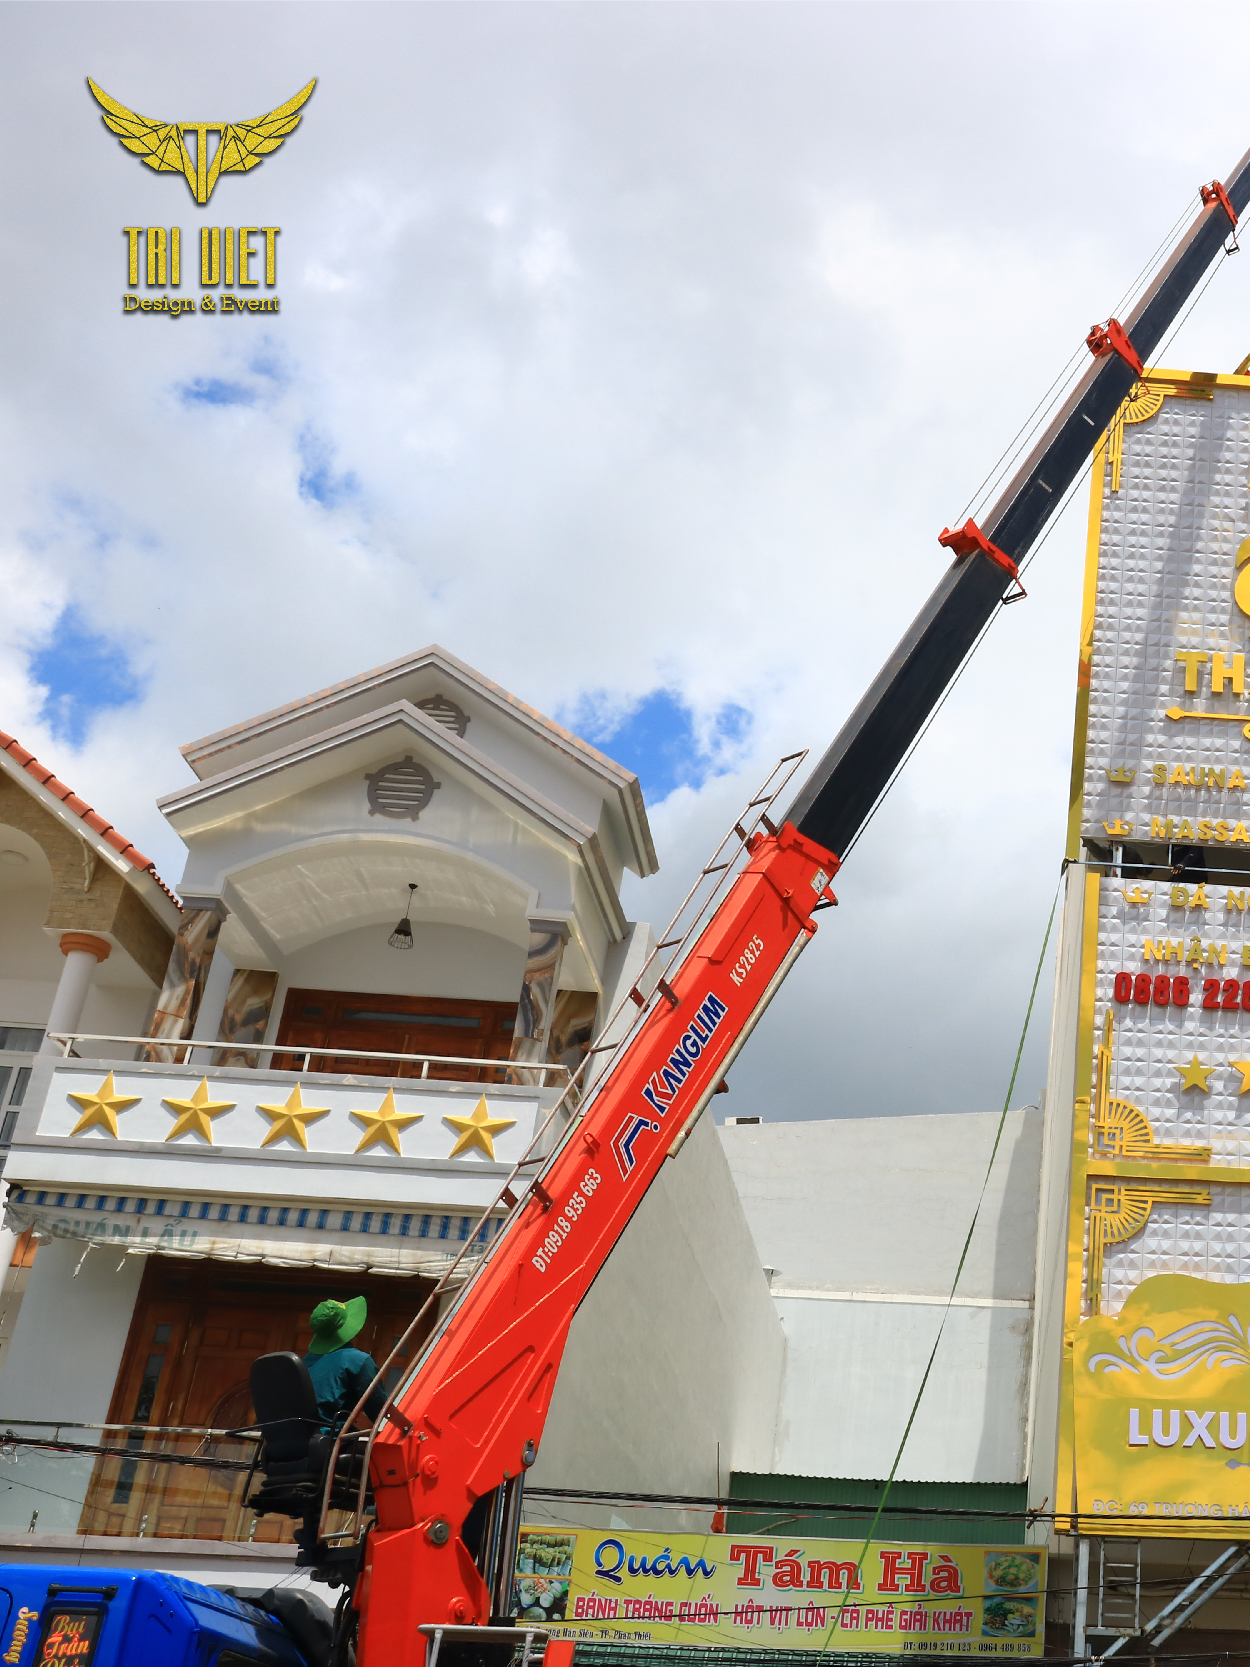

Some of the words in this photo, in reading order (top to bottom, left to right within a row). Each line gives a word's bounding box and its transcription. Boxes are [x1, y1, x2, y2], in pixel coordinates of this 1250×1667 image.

[1152, 764, 1248, 790] SAUNA
[1170, 882, 1209, 909] ĐÁ
[729, 934, 765, 987] KS2825
[1143, 936, 1228, 969] NHẬN
[1114, 971, 1190, 1006] 0886
[641, 991, 728, 1117] KANGLIM
[52, 1218, 130, 1239] QUÁN
[140, 1219, 199, 1248] LẨU
[532, 1216, 571, 1273] ĐT:0918
[564, 1191, 587, 1221] 935
[580, 1168, 601, 1197] 663
[1093, 1499, 1123, 1513] ĐC:
[1129, 1501, 1148, 1515] 69
[594, 1538, 717, 1585] Quán
[729, 1544, 863, 1592] Tám
[877, 1550, 964, 1596] Hà
[573, 1590, 619, 1620] BÁNH
[623, 1592, 674, 1623] TRÁNG
[677, 1592, 721, 1625] CUỐN
[732, 1598, 764, 1632] HỘT
[769, 1605, 793, 1633] VỊT
[796, 1600, 827, 1634] LỘN
[840, 1602, 861, 1631] CÀ
[864, 1603, 895, 1631] PHÊ
[898, 1602, 929, 1632] GIẢI
[932, 1604, 974, 1633] KHÁT
[613, 1630, 632, 1640] Phan
[918, 1642, 938, 1651] 0919
[940, 1643, 955, 1651] 210
[957, 1643, 972, 1652] 123
[978, 1643, 998, 1652] 0964
